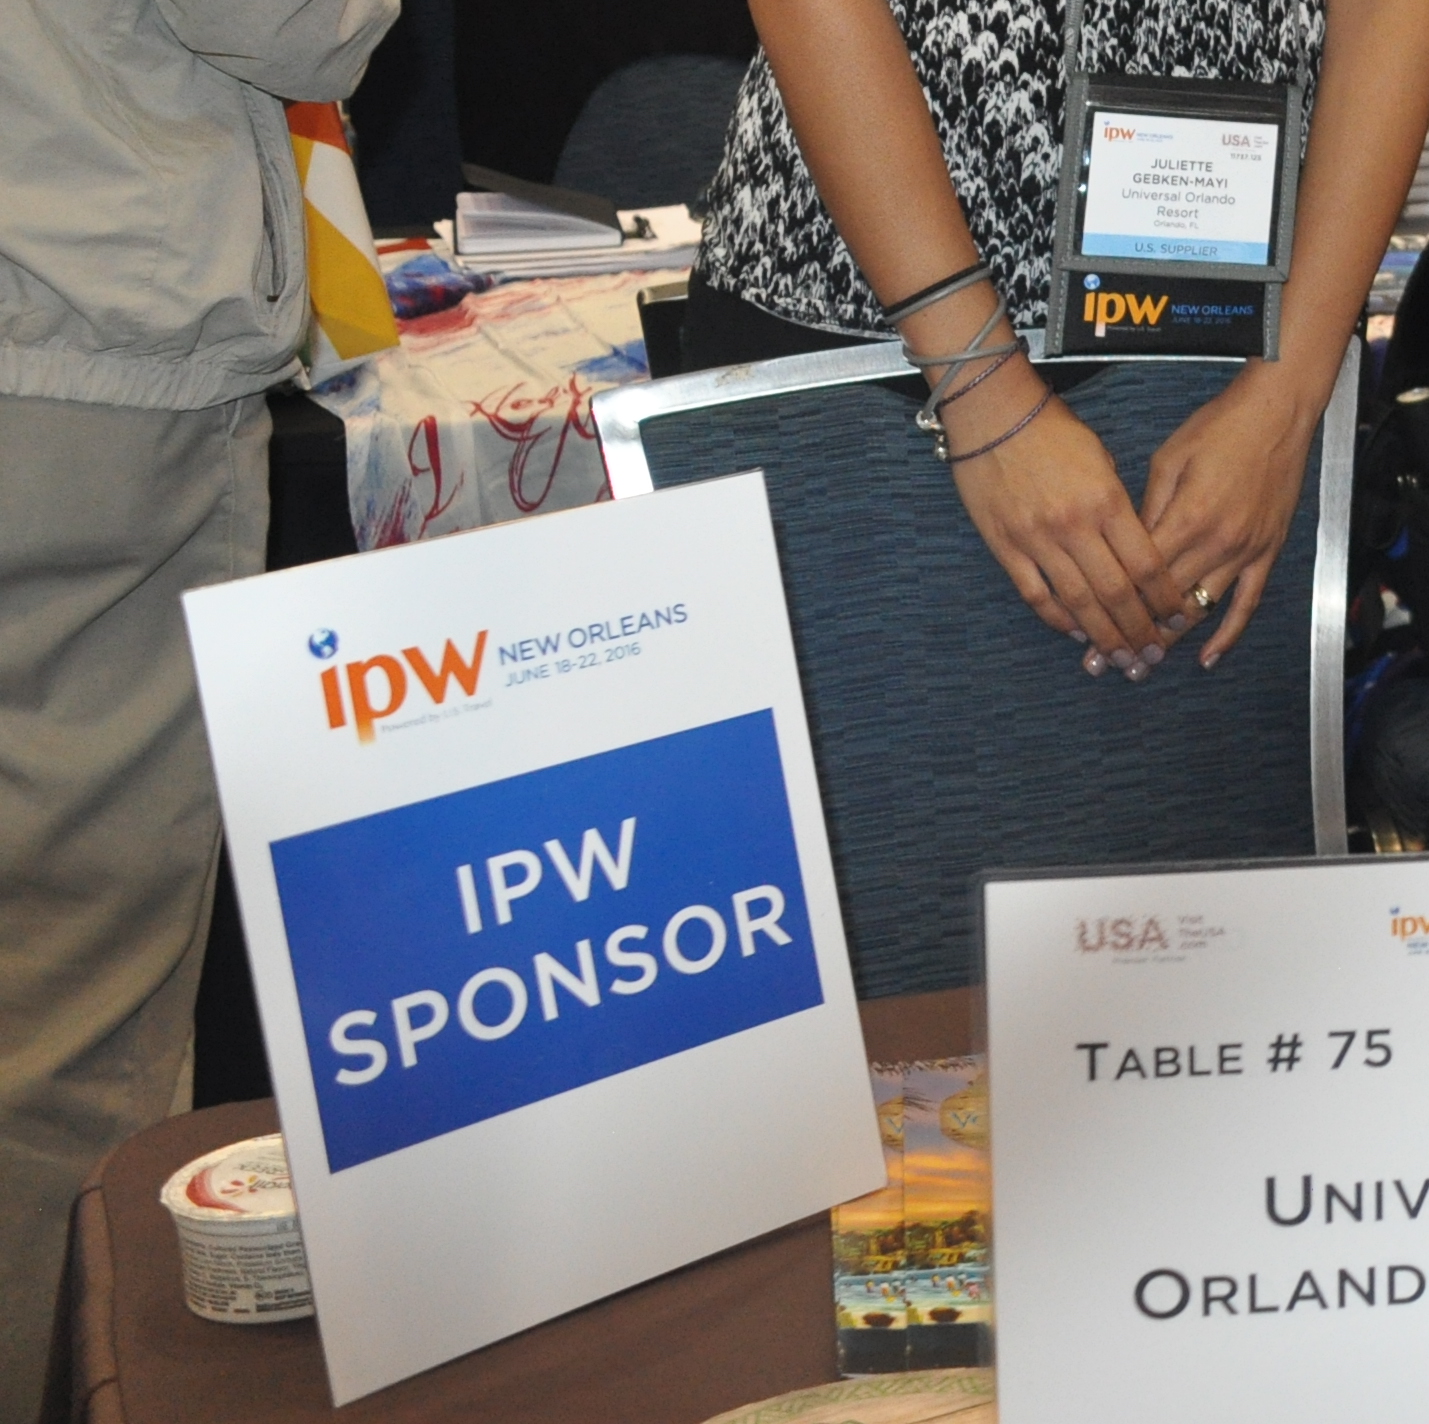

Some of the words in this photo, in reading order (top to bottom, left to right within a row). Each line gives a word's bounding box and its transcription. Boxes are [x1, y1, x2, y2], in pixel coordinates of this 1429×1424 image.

[1104, 121, 1136, 142] ipw
[1222, 133, 1250, 148] USA
[1151, 158, 1213, 172] JULIETTE
[1133, 174, 1228, 189] GEBKEN-MAYI
[1122, 189, 1181, 202] Universal
[1185, 192, 1236, 205] Orlando
[1157, 206, 1199, 219] Resort
[1134, 243, 1155, 253] U.S.
[1161, 245, 1218, 256] SUPPLIER
[1083, 274, 1169, 337] ipw
[1171, 304, 1200, 315] NEW
[1202, 305, 1254, 316] ORLEANS
[498, 632, 562, 666] NEW
[567, 604, 689, 649] ORLEANS
[505, 664, 551, 688] JUNE
[555, 653, 602, 675] 18-22,
[605, 641, 642, 664] 2016
[308, 627, 489, 747] ipw
[456, 817, 638, 933] IPW
[1075, 914, 1169, 953] USA
[329, 884, 793, 1087] SPONSOR
[1266, 1033, 1304, 1073] #
[1327, 1028, 1394, 1072] 75
